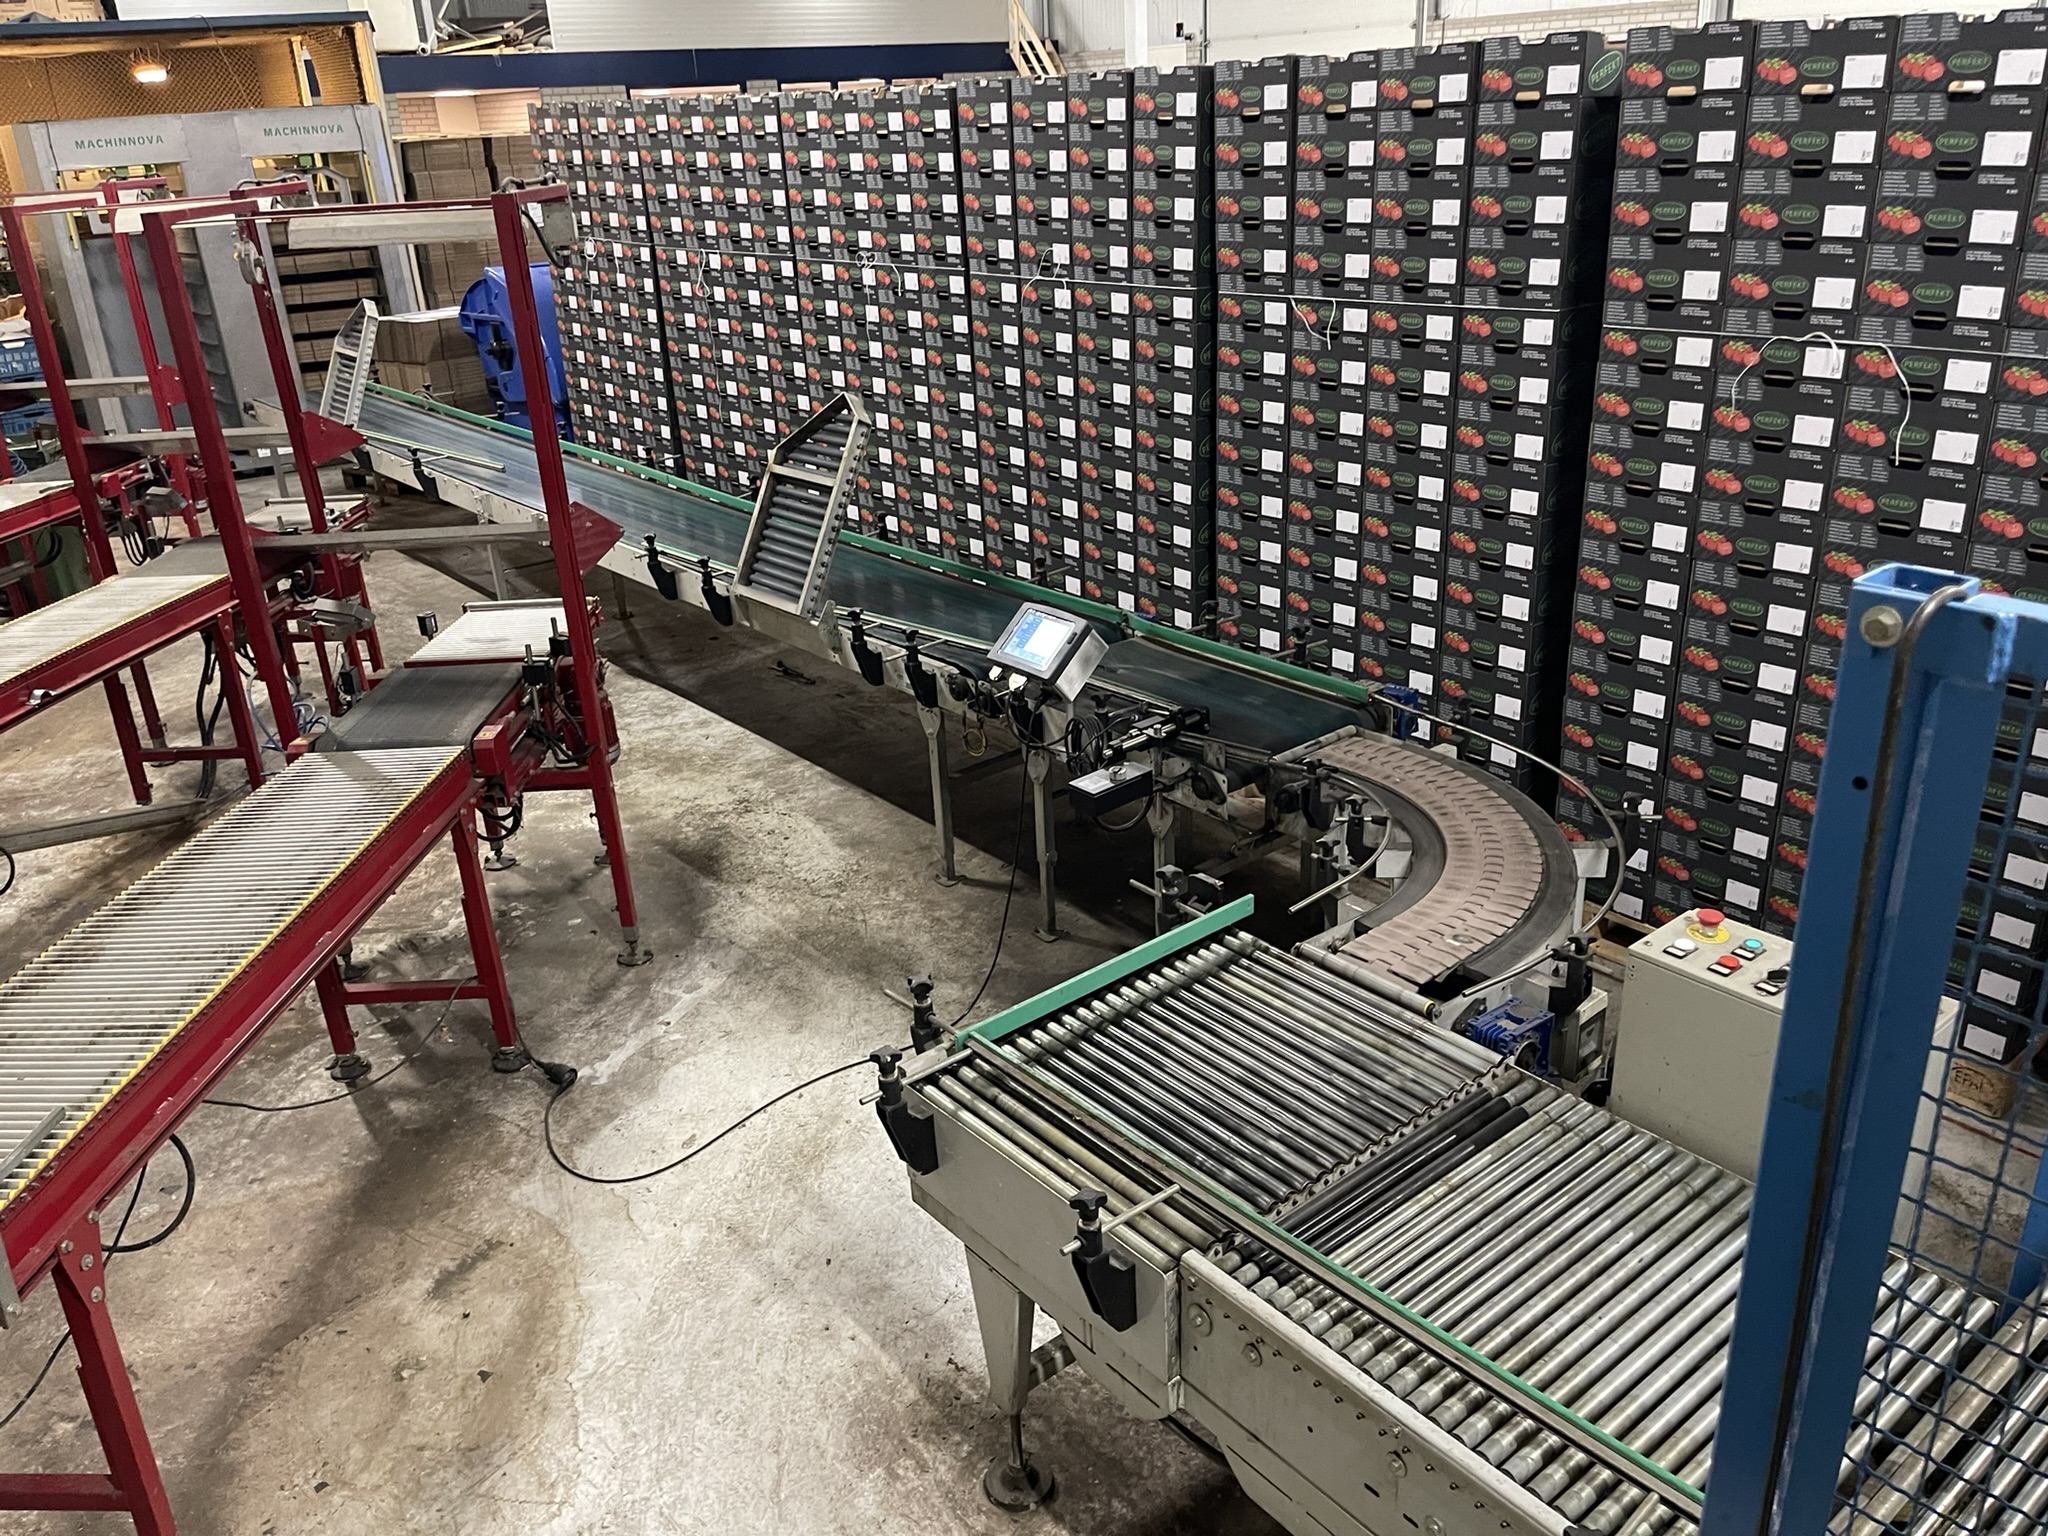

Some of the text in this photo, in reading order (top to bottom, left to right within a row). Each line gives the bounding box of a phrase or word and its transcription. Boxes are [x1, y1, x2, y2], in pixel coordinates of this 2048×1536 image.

[1951, 57, 1986, 67] PERFEKT
[1591, 57, 1620, 84] PERFEKT
[1668, 65, 1696, 75] PERFEKT
[1803, 62, 1835, 72] PERFEKT
[1517, 72, 1541, 80] PERFEKT
[263, 124, 345, 137] MACHINNOVA
[75, 135, 164, 150] MACHINNOVA
[1511, 137, 1535, 145] PERFEKT
[1662, 136, 1690, 146] PERFEKT
[1794, 136, 1824, 146] PERFEKT
[1939, 137, 1974, 147] PERFEKT
[1506, 199, 1529, 207] PERFEKT
[1656, 207, 1682, 215] PERFEKT
[1785, 209, 1815, 218] PERFEKT
[1928, 213, 1962, 222] PERFEKT
[1501, 261, 1523, 269] PERFEKT
[1649, 274, 1675, 283] PERFEKT
[1775, 281, 1804, 290] PERFEKT
[1916, 289, 1950, 297] PERFEKT
[1642, 339, 1669, 347] PERFEKT
[1767, 349, 1797, 358] PERFEKT
[1904, 361, 1938, 370] PERFEKT
[1491, 378, 1513, 386] PERFEKT
[1634, 401, 1661, 409] PERFEKT
[1756, 416, 1785, 425] PERFEKT
[1487, 434, 1509, 442] PERFEKT
[1628, 462, 1654, 471] PERFEKT
[1748, 479, 1776, 489] PERFEKT
[1483, 488, 1505, 496] PERFEKT
[1880, 498, 1914, 508] PERFEKT
[1622, 521, 1648, 531] PERFEKT
[1480, 541, 1500, 549] PERFEKT
[1738, 541, 1766, 552] PERFEKT
[1615, 578, 1640, 588] PERFEKT
[1732, 602, 1760, 612] PERFEKT
[1725, 659, 1752, 669] PERFEKT
